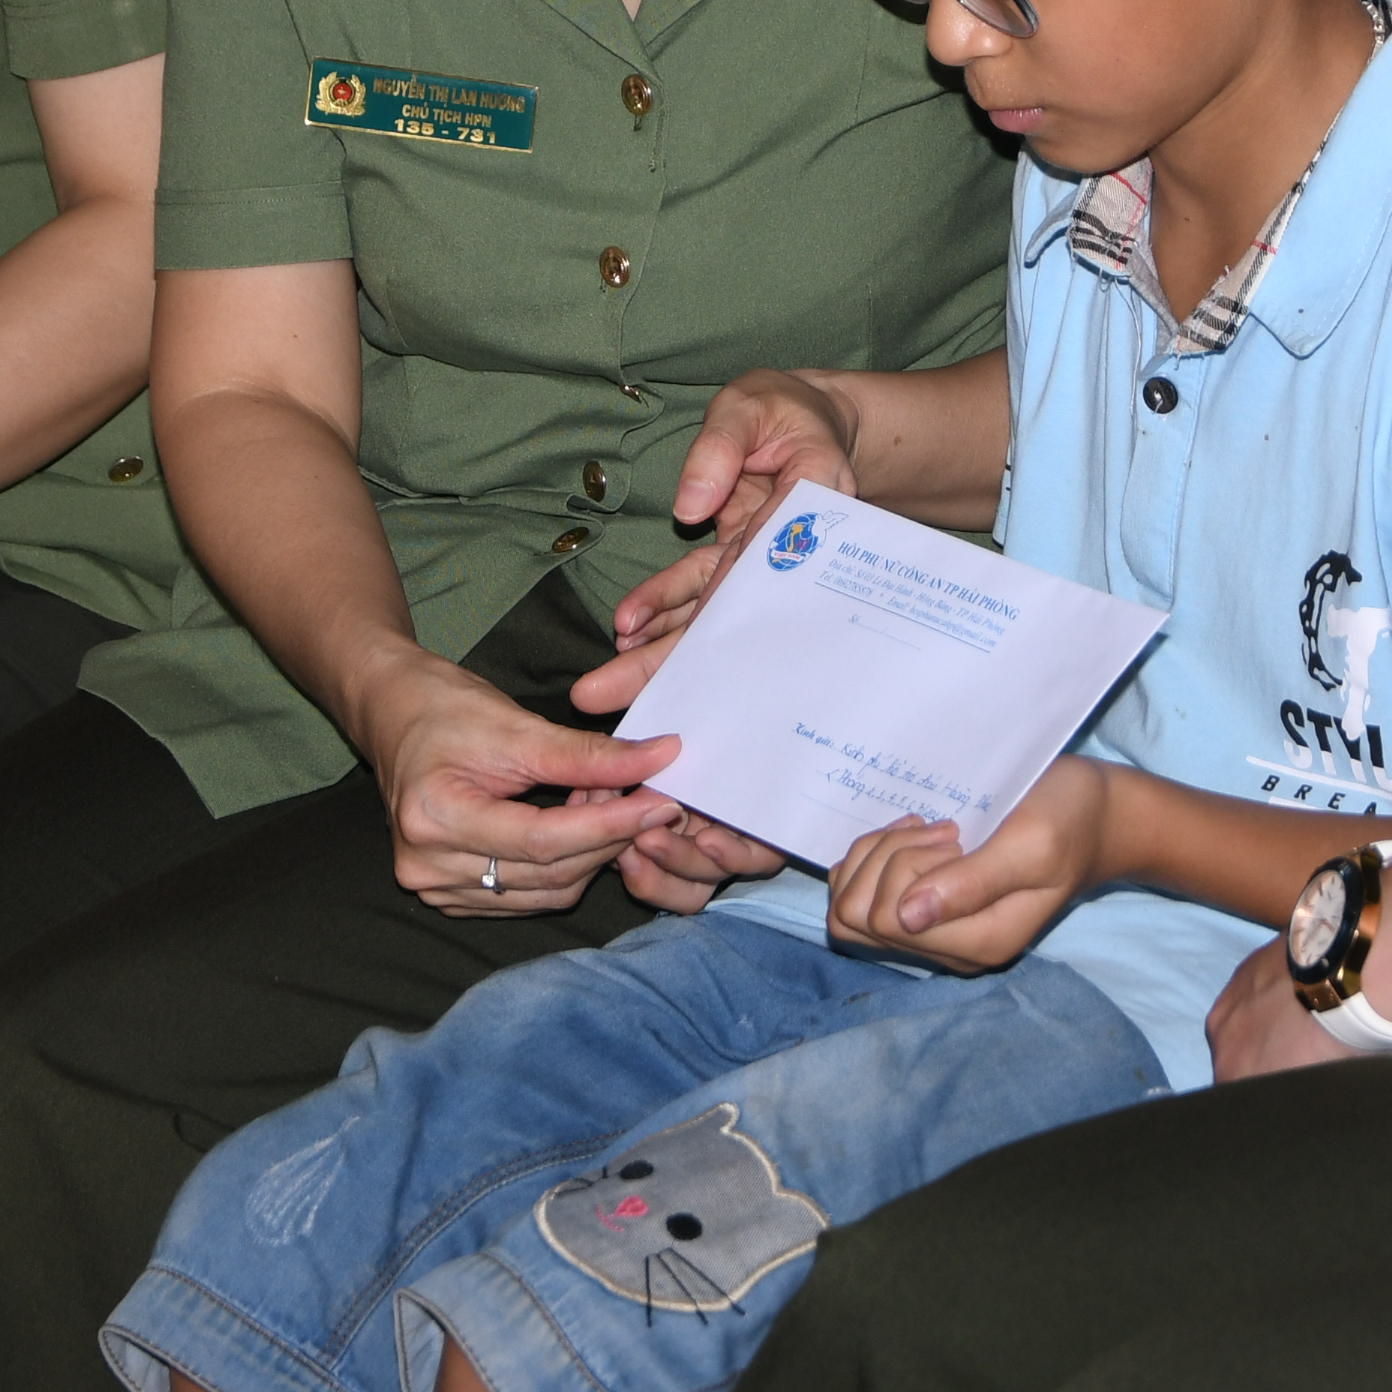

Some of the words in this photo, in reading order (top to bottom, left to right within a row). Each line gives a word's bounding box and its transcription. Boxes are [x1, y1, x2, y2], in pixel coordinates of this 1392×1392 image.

[452, 88, 478, 106] LAN
[402, 102, 429, 119] CHỦ
[433, 108, 462, 125] TỊCH
[465, 112, 493, 128] HPN
